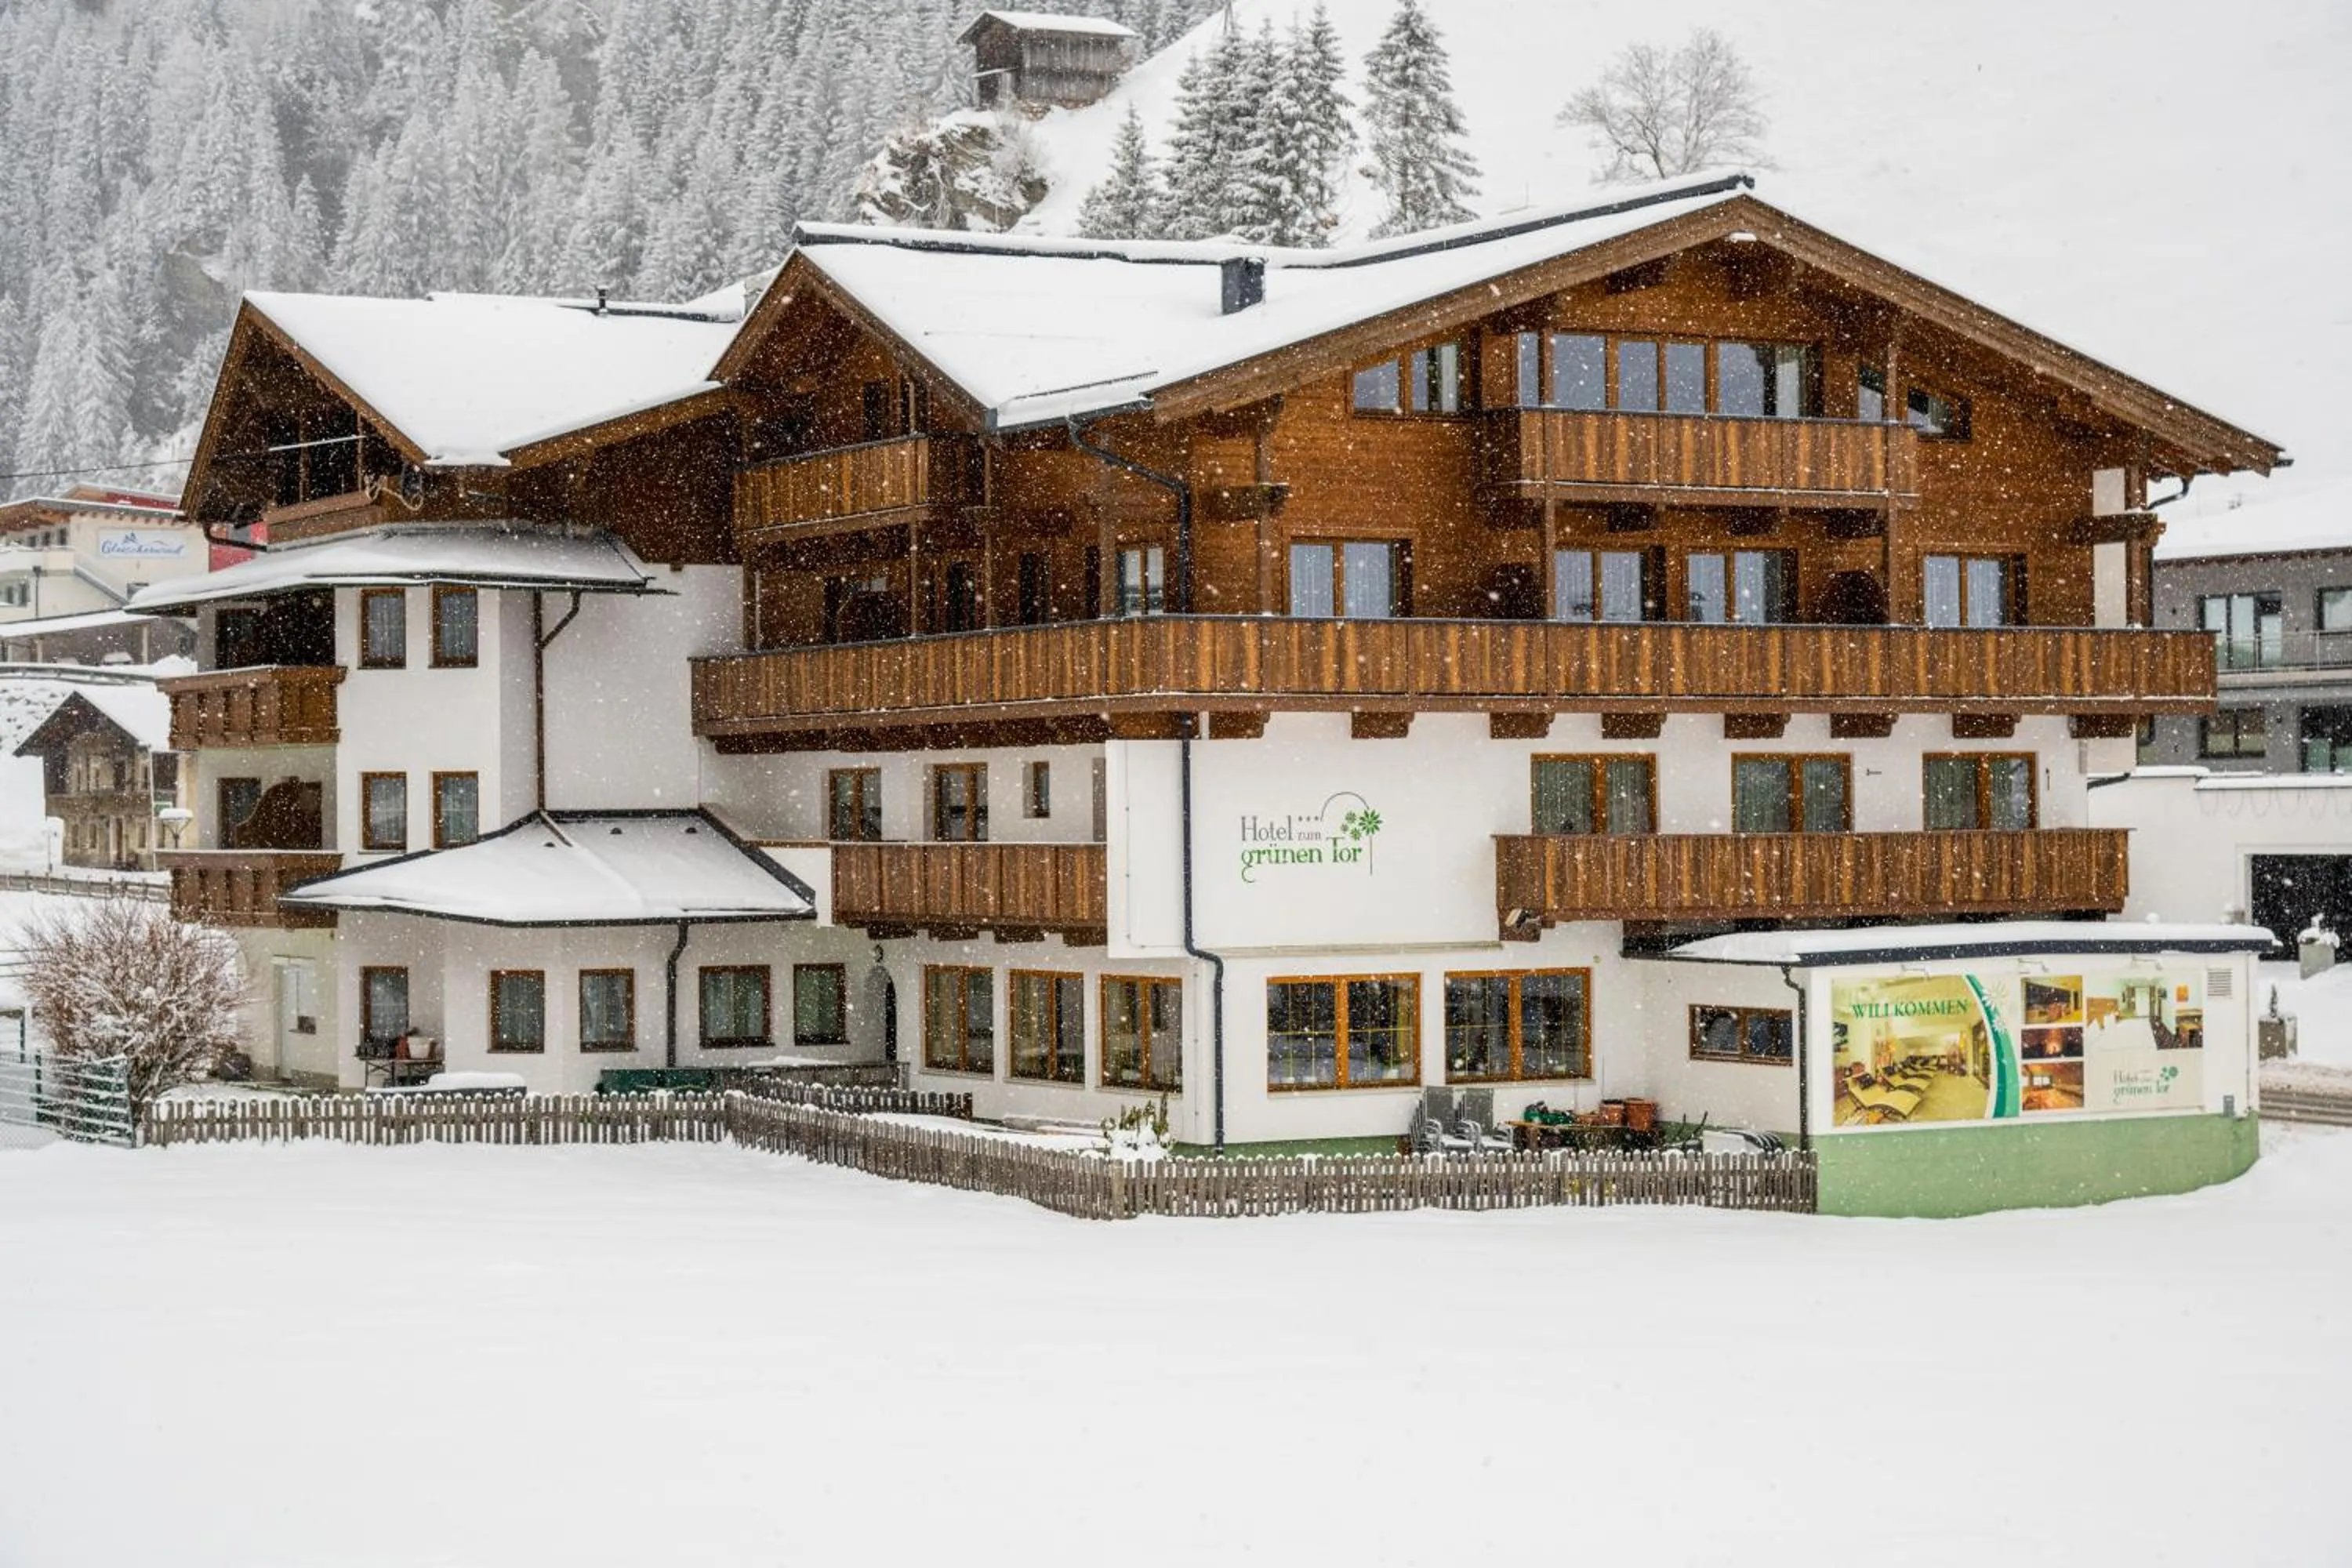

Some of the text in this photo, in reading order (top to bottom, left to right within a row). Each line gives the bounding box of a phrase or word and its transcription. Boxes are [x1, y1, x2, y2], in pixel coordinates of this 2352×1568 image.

[1241, 815, 1322, 841] Hotel zum
[1241, 837, 1363, 884] grünen Tor
[1852, 999, 1969, 1018] WILLKOMMEN
